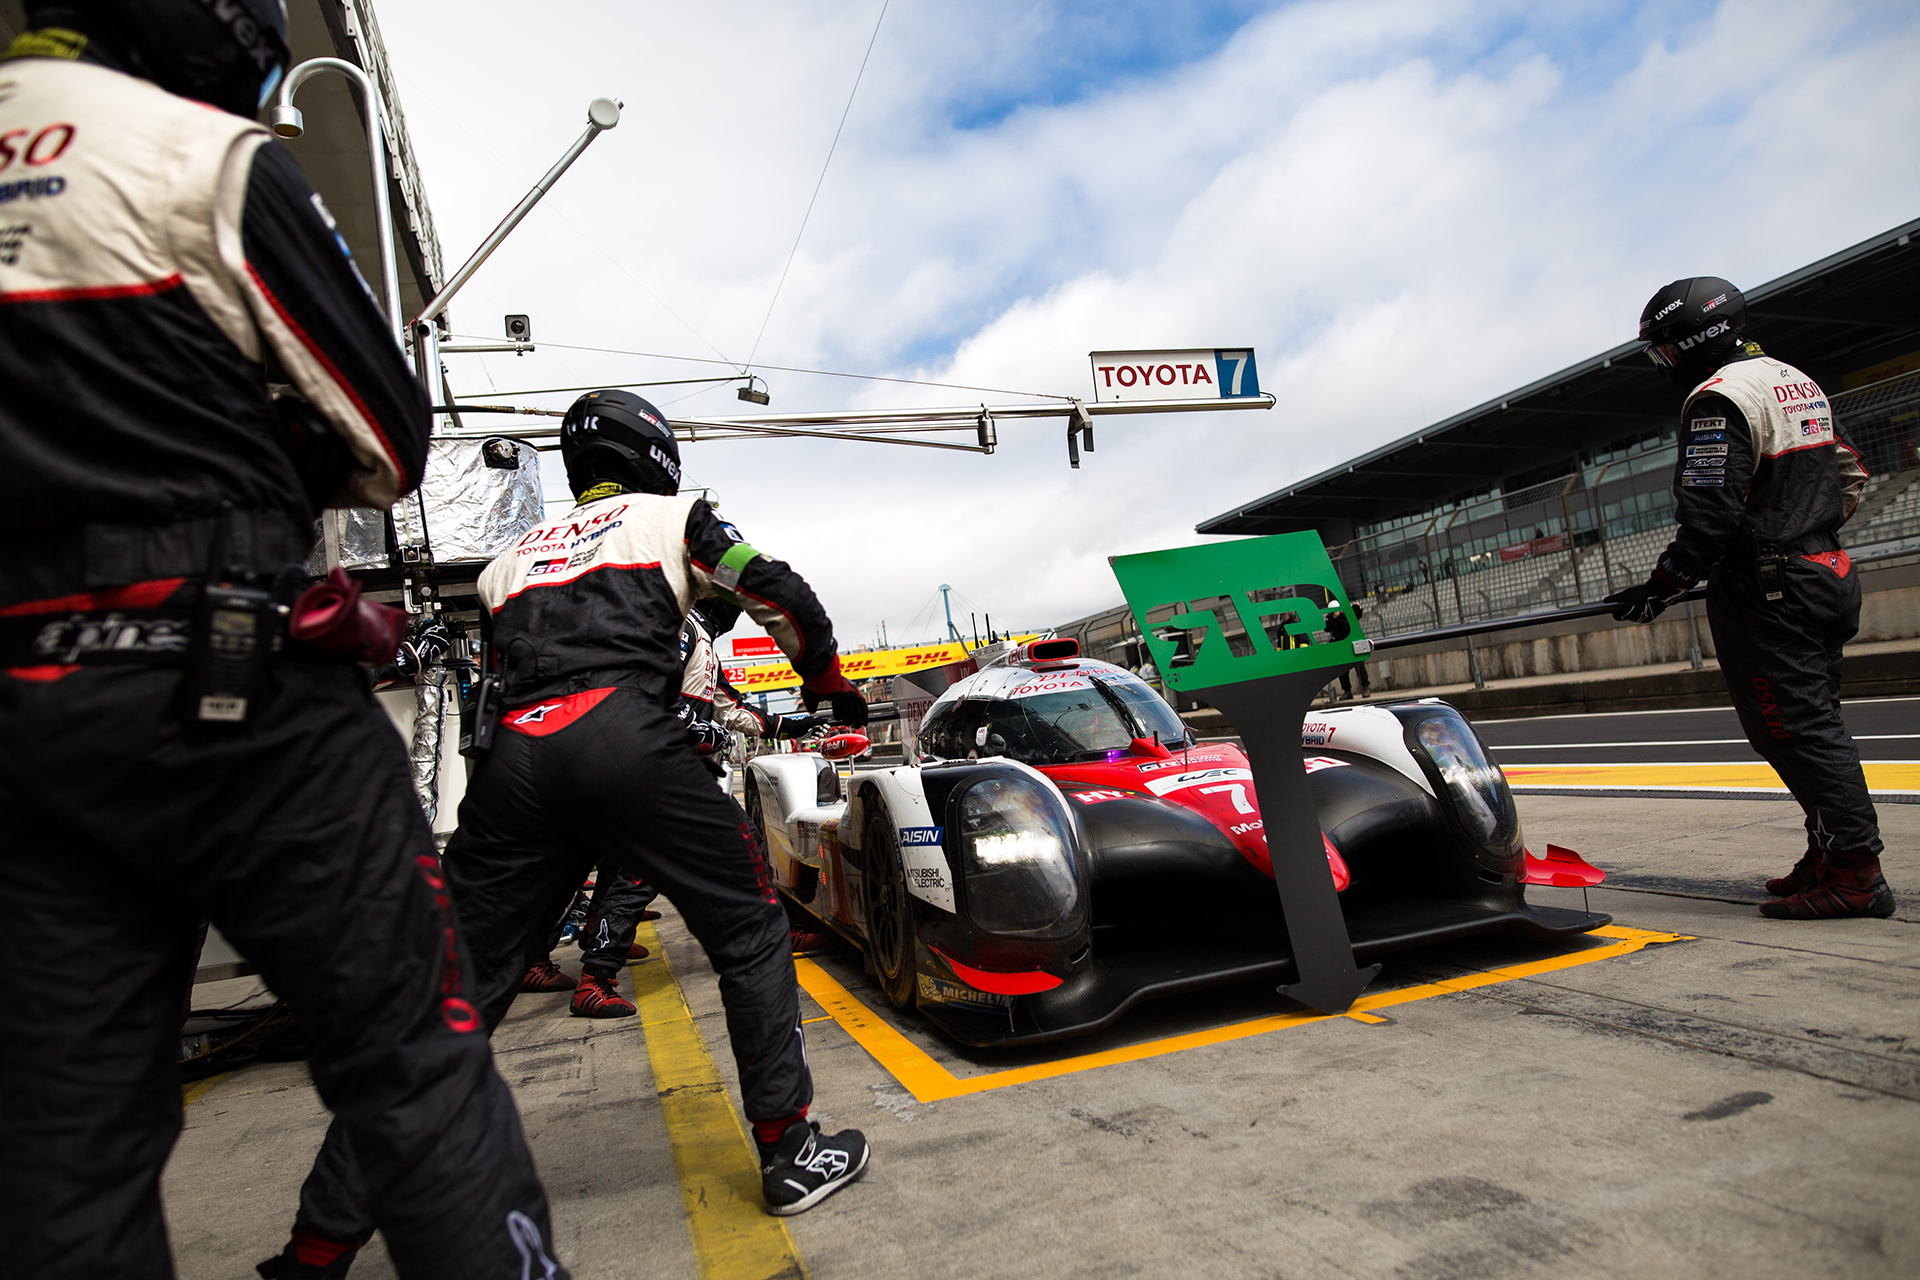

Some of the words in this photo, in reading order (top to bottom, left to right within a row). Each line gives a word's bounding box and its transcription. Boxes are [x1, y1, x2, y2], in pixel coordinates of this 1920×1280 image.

[1655, 299, 1684, 321] uvex
[1678, 319, 1730, 351] uvex
[1098, 364, 1212, 387] TOYOTA
[1222, 352, 1248, 395] 7
[1773, 382, 1820, 403] DENSO
[1782, 403, 1809, 415] TOYOTA
[1693, 420, 1724, 430] JTEKT
[1802, 425, 1819, 436] GR
[649, 444, 679, 484] uvex
[1686, 458, 1726, 468] RAYS
[518, 505, 629, 547] DENSO
[516, 543, 566, 557] TOYOTA
[570, 521, 622, 549] HYBRID
[528, 563, 565, 575] GR
[906, 651, 952, 666] DHL
[729, 669, 744, 681] 25
[747, 670, 797, 684] DHL
[1039, 668, 1118, 683] DENSO
[1012, 681, 1084, 696] TOYOTA
[1752, 677, 1790, 739] DENSO
[1327, 727, 1336, 743] 7
[1074, 791, 1125, 803] HY
[1199, 783, 1256, 815] 7
[1230, 819, 1263, 835] Mo
[902, 830, 939, 843] AISIN
[739, 822, 777, 904] DENSO
[942, 986, 1016, 1006] MICHELIN
